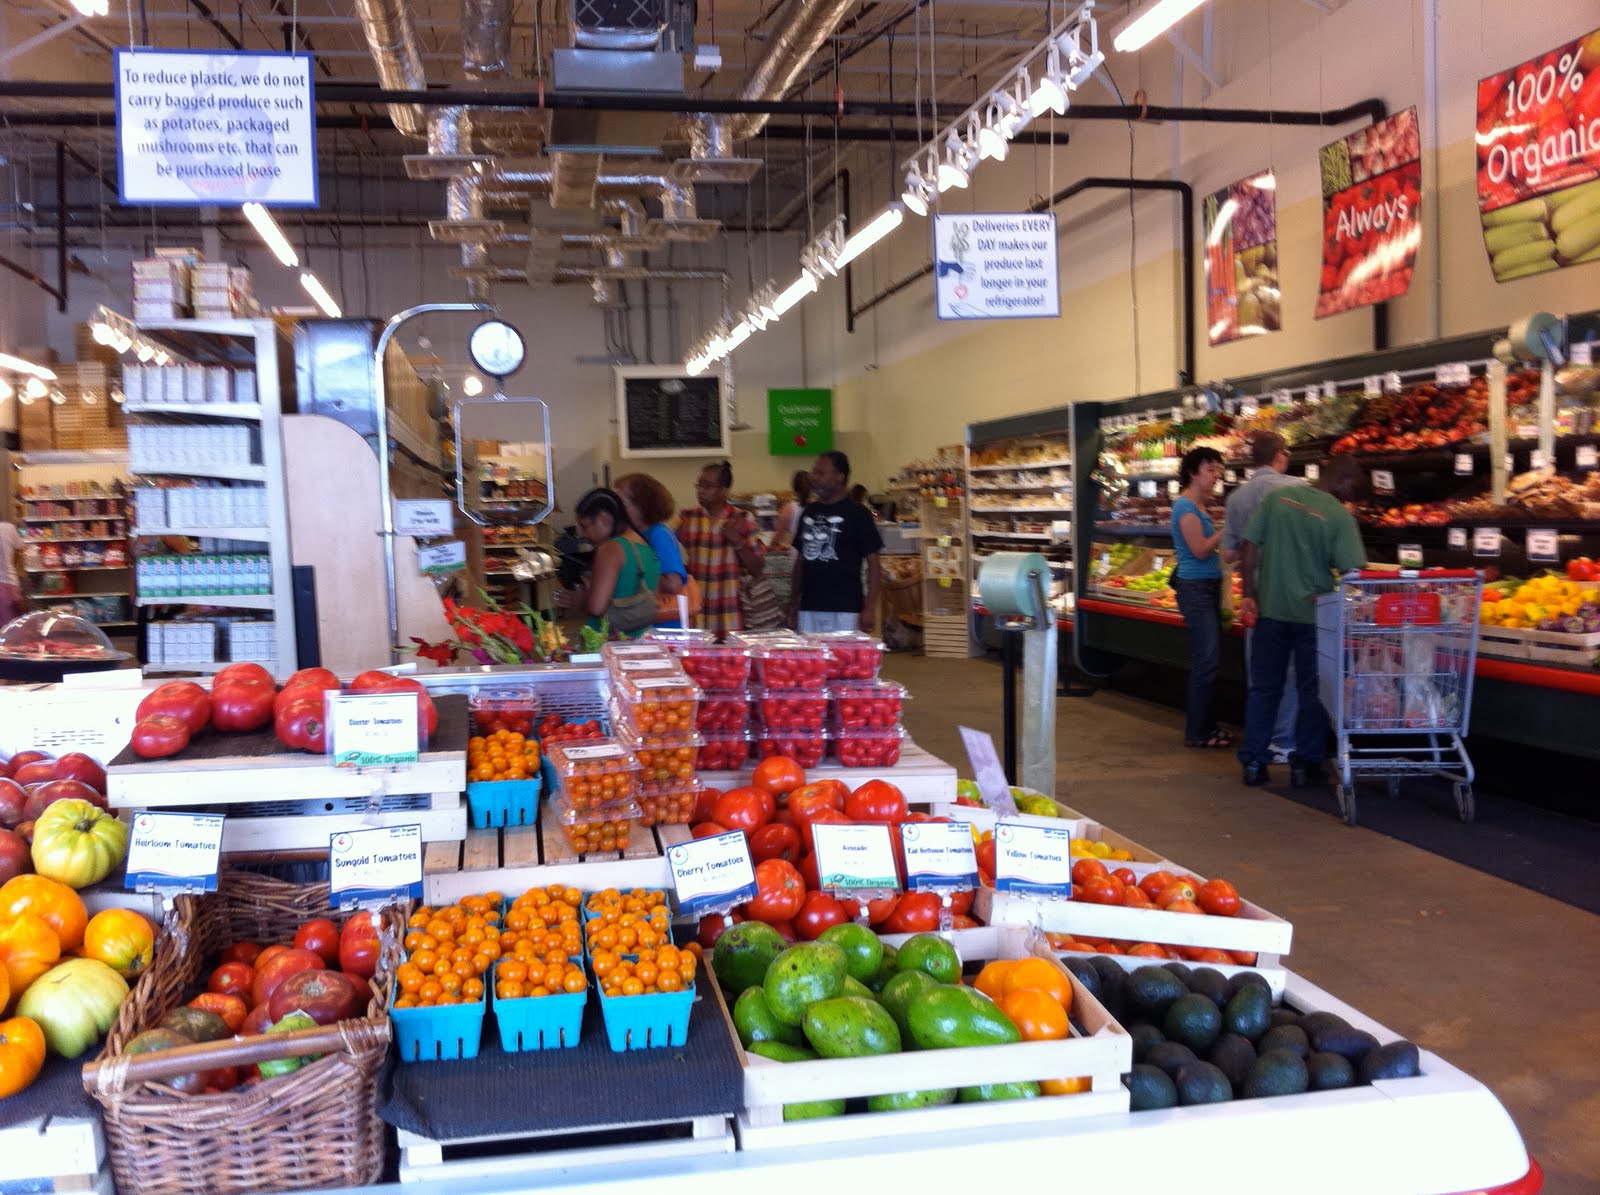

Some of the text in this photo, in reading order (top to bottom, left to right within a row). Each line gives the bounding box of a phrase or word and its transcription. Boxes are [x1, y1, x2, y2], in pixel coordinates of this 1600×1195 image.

[124, 68, 305, 87] To reduce plastic, we do not
[1505, 46, 1584, 118] 100%
[128, 93, 303, 111] carry bagged produce such
[144, 117, 289, 134] as potatoes, packaged
[137, 140, 215, 155] mushrooms
[245, 141, 272, 155] that
[276, 143, 299, 155] can
[1487, 113, 1600, 185] Organic
[156, 162, 281, 178] be purchased loose
[972, 219, 1051, 232] Deliveries EVERY
[1334, 194, 1408, 242] Always
[977, 238, 1048, 251] DAY makes our
[984, 256, 1044, 271] produce last
[980, 276, 1048, 290] longer in your
[361, 755, 417, 764] 100% Organic
[135, 838, 216, 850] Heirloom Tomatoes
[335, 852, 417, 868] Sungold Tomatoes
[1006, 849, 1062, 862] Yellow Tomatoes
[677, 866, 704, 878] Cherry
[706, 856, 744, 871] Tomatoes
